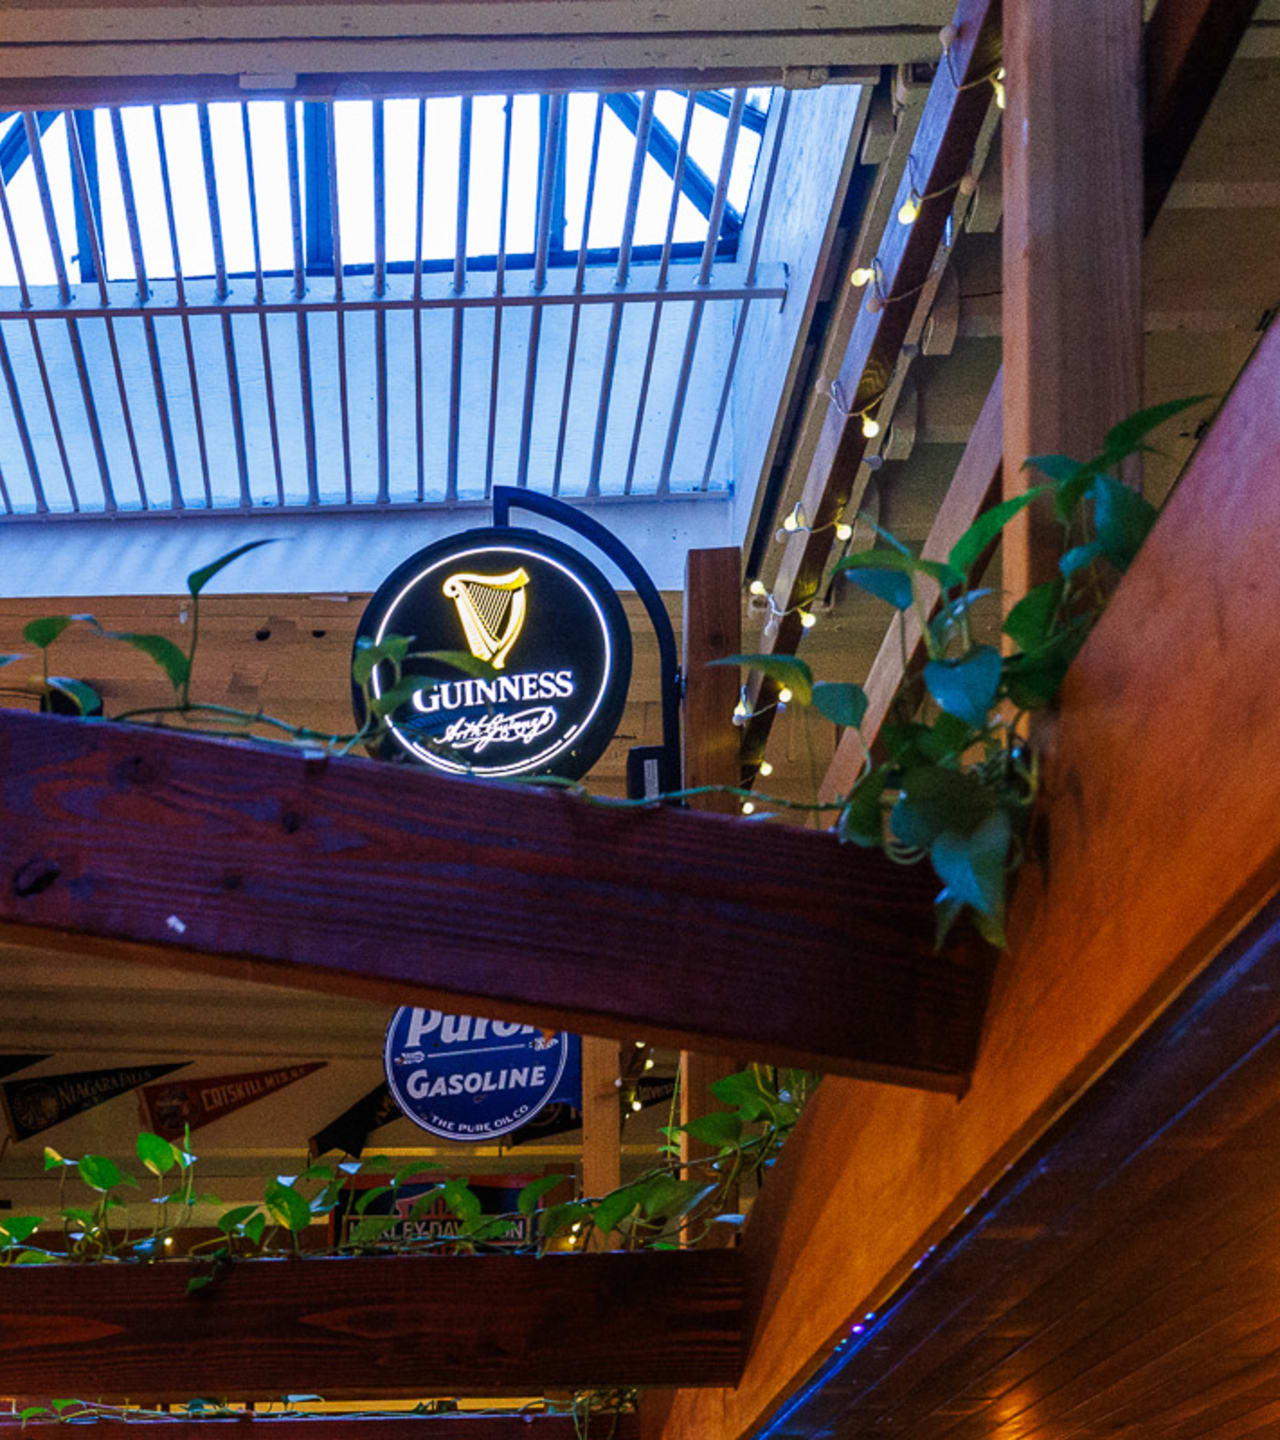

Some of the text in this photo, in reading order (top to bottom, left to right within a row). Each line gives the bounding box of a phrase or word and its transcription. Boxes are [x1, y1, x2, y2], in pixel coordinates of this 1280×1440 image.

[412, 669, 574, 714] GUINNESS
[406, 1065, 547, 1100] GASOLINE
[430, 1115, 455, 1132] THE
[458, 1123, 491, 1134] PURE
[494, 1115, 515, 1130] OIL
